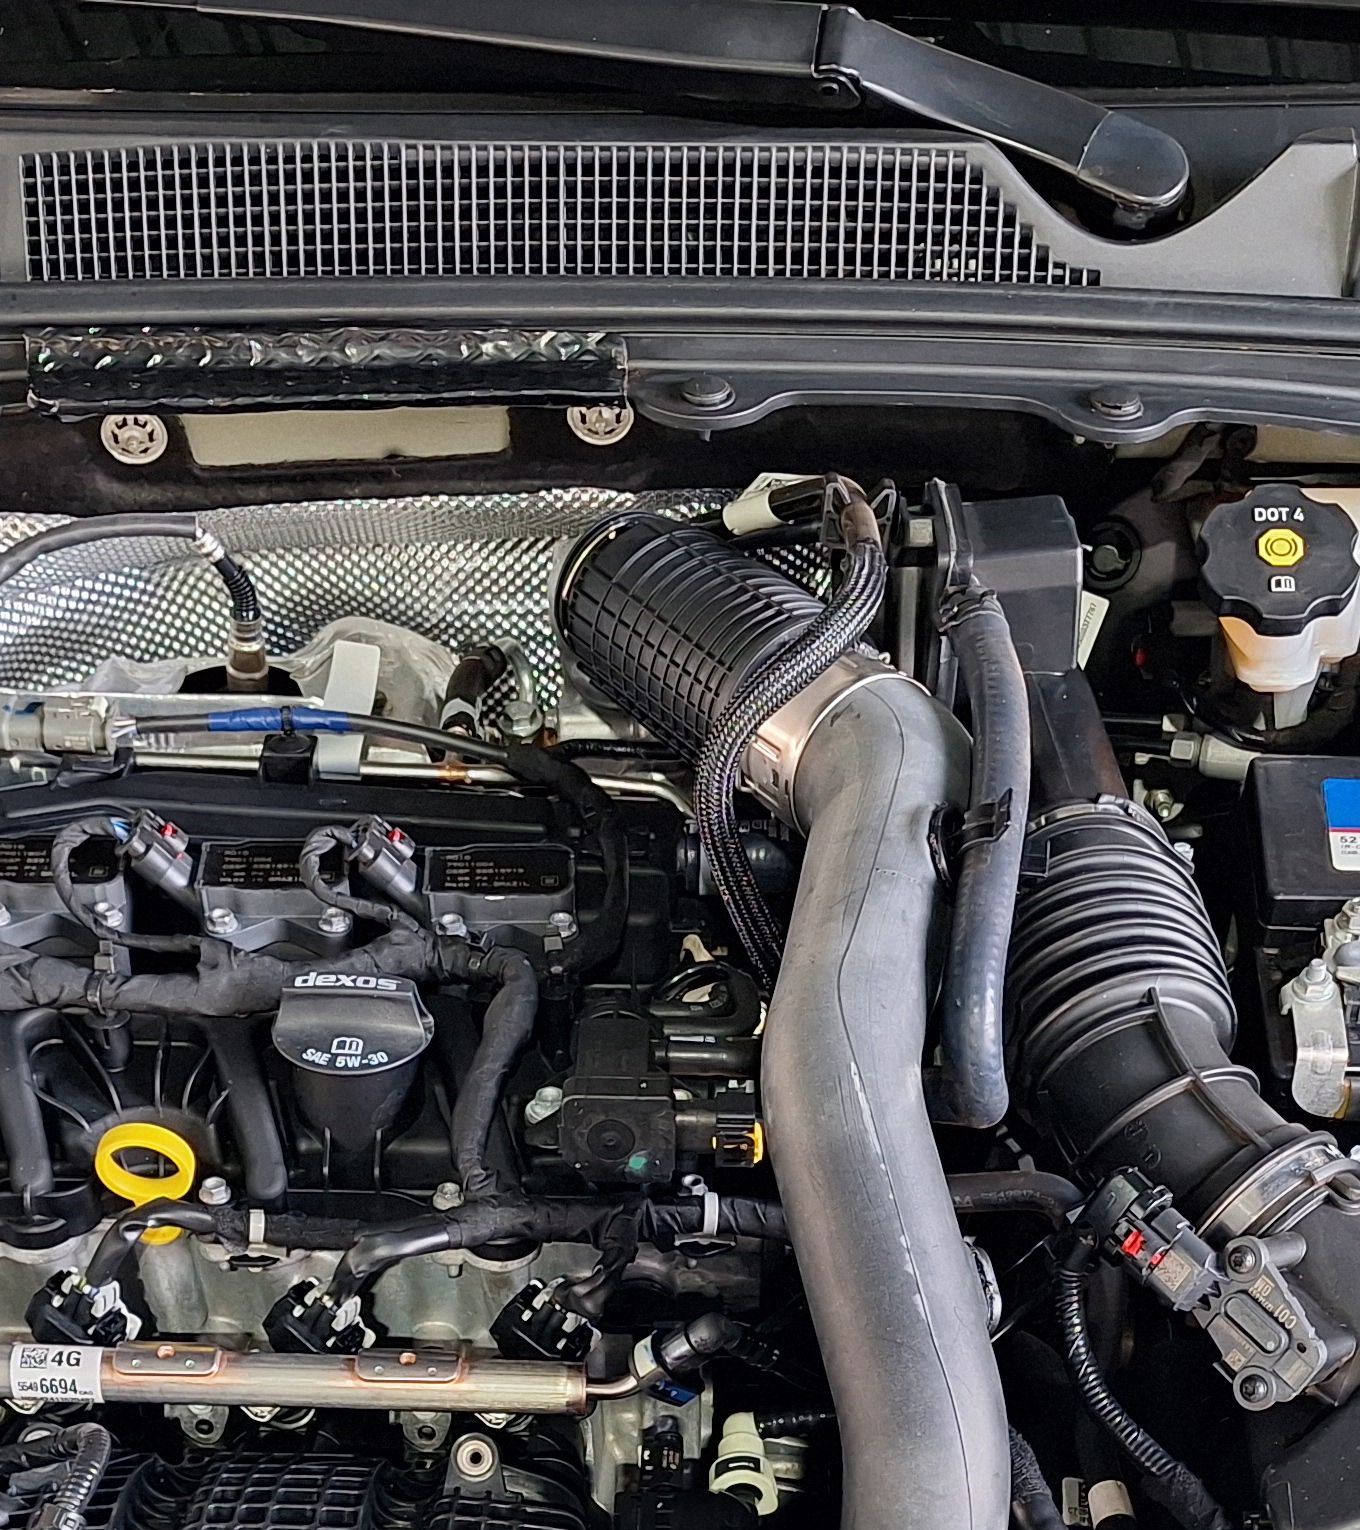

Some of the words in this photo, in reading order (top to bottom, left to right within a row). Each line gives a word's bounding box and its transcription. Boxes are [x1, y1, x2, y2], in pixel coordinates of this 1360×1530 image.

[1253, 507, 1290, 522] DOT
[1293, 506, 1305, 522] 4
[293, 971, 403, 991] dexos
[301, 1048, 332, 1067] SAE
[335, 1051, 389, 1068] 5W-30
[50, 1350, 82, 1367] 4G
